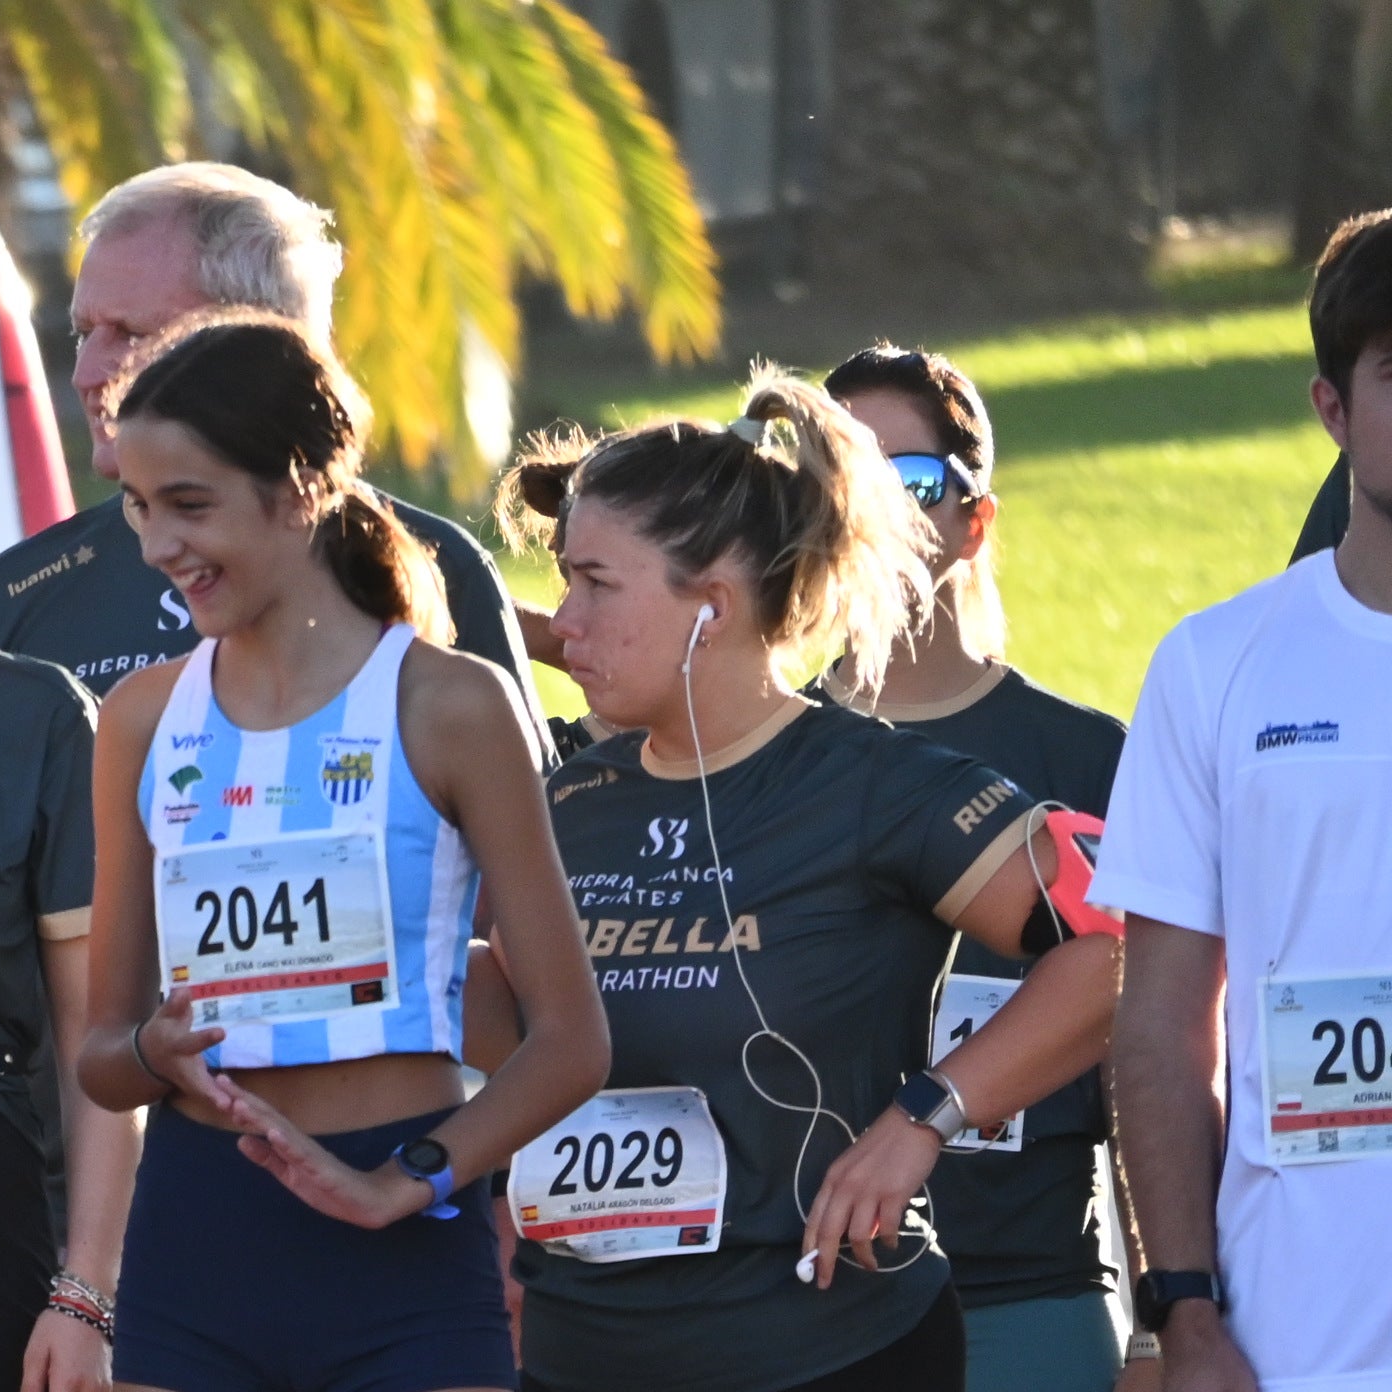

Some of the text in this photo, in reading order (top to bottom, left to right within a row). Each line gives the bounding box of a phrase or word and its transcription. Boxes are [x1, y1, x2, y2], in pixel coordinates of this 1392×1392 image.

[6, 553, 71, 598] luanvi
[74, 652, 168, 679] SIERRA
[648, 866, 735, 885] ANCA
[194, 876, 331, 956] 2041
[224, 959, 255, 974] ELENA
[593, 965, 720, 997] RATHON
[1311, 1017, 1392, 1086] 20
[548, 1126, 684, 1197] 2029
[569, 1201, 607, 1213] NATALIA
